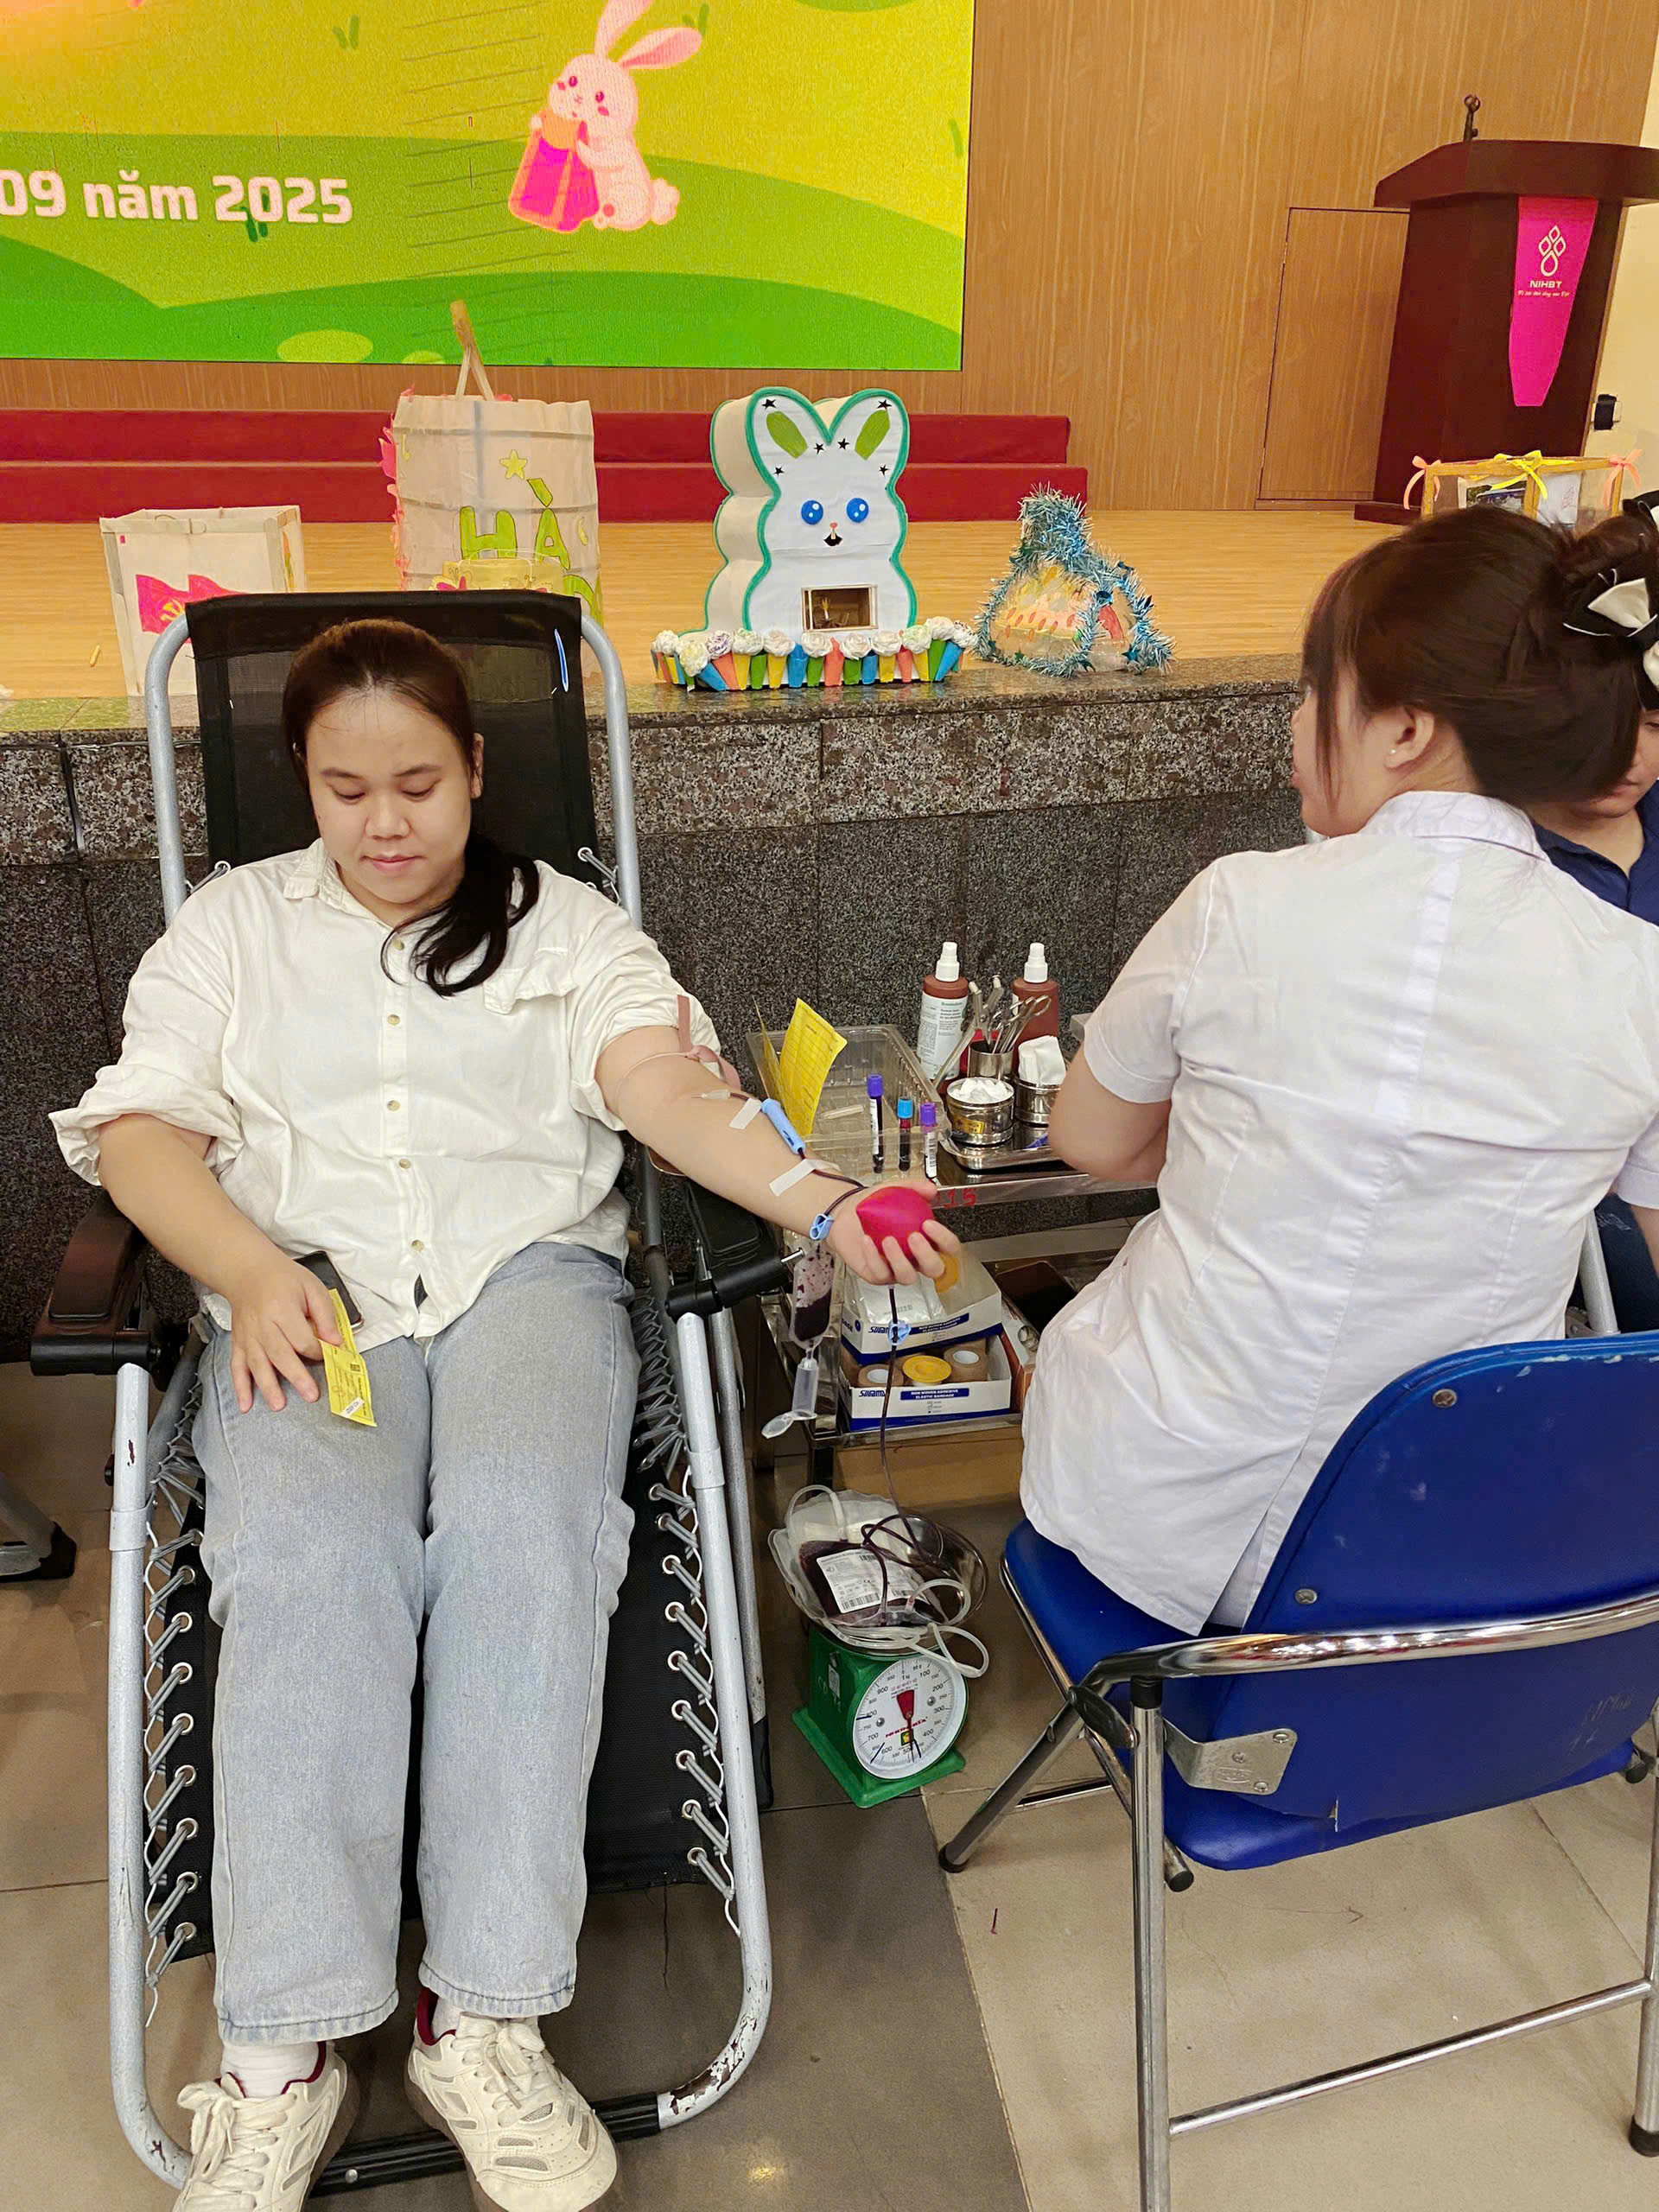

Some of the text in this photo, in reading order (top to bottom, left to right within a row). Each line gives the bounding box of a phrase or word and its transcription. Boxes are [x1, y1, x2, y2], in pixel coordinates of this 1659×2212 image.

[0, 169, 353, 224] 09 năm 2025
[1529, 280, 1562, 289] NIHBT
[919, 1669, 931, 1678] 100
[877, 1686, 889, 1694] 900
[932, 1683, 944, 1693] 200
[933, 1705, 945, 1714] 300
[868, 1732, 879, 1741] 700
[923, 1728, 934, 1737] 400
[880, 1745, 893, 1755] 600
